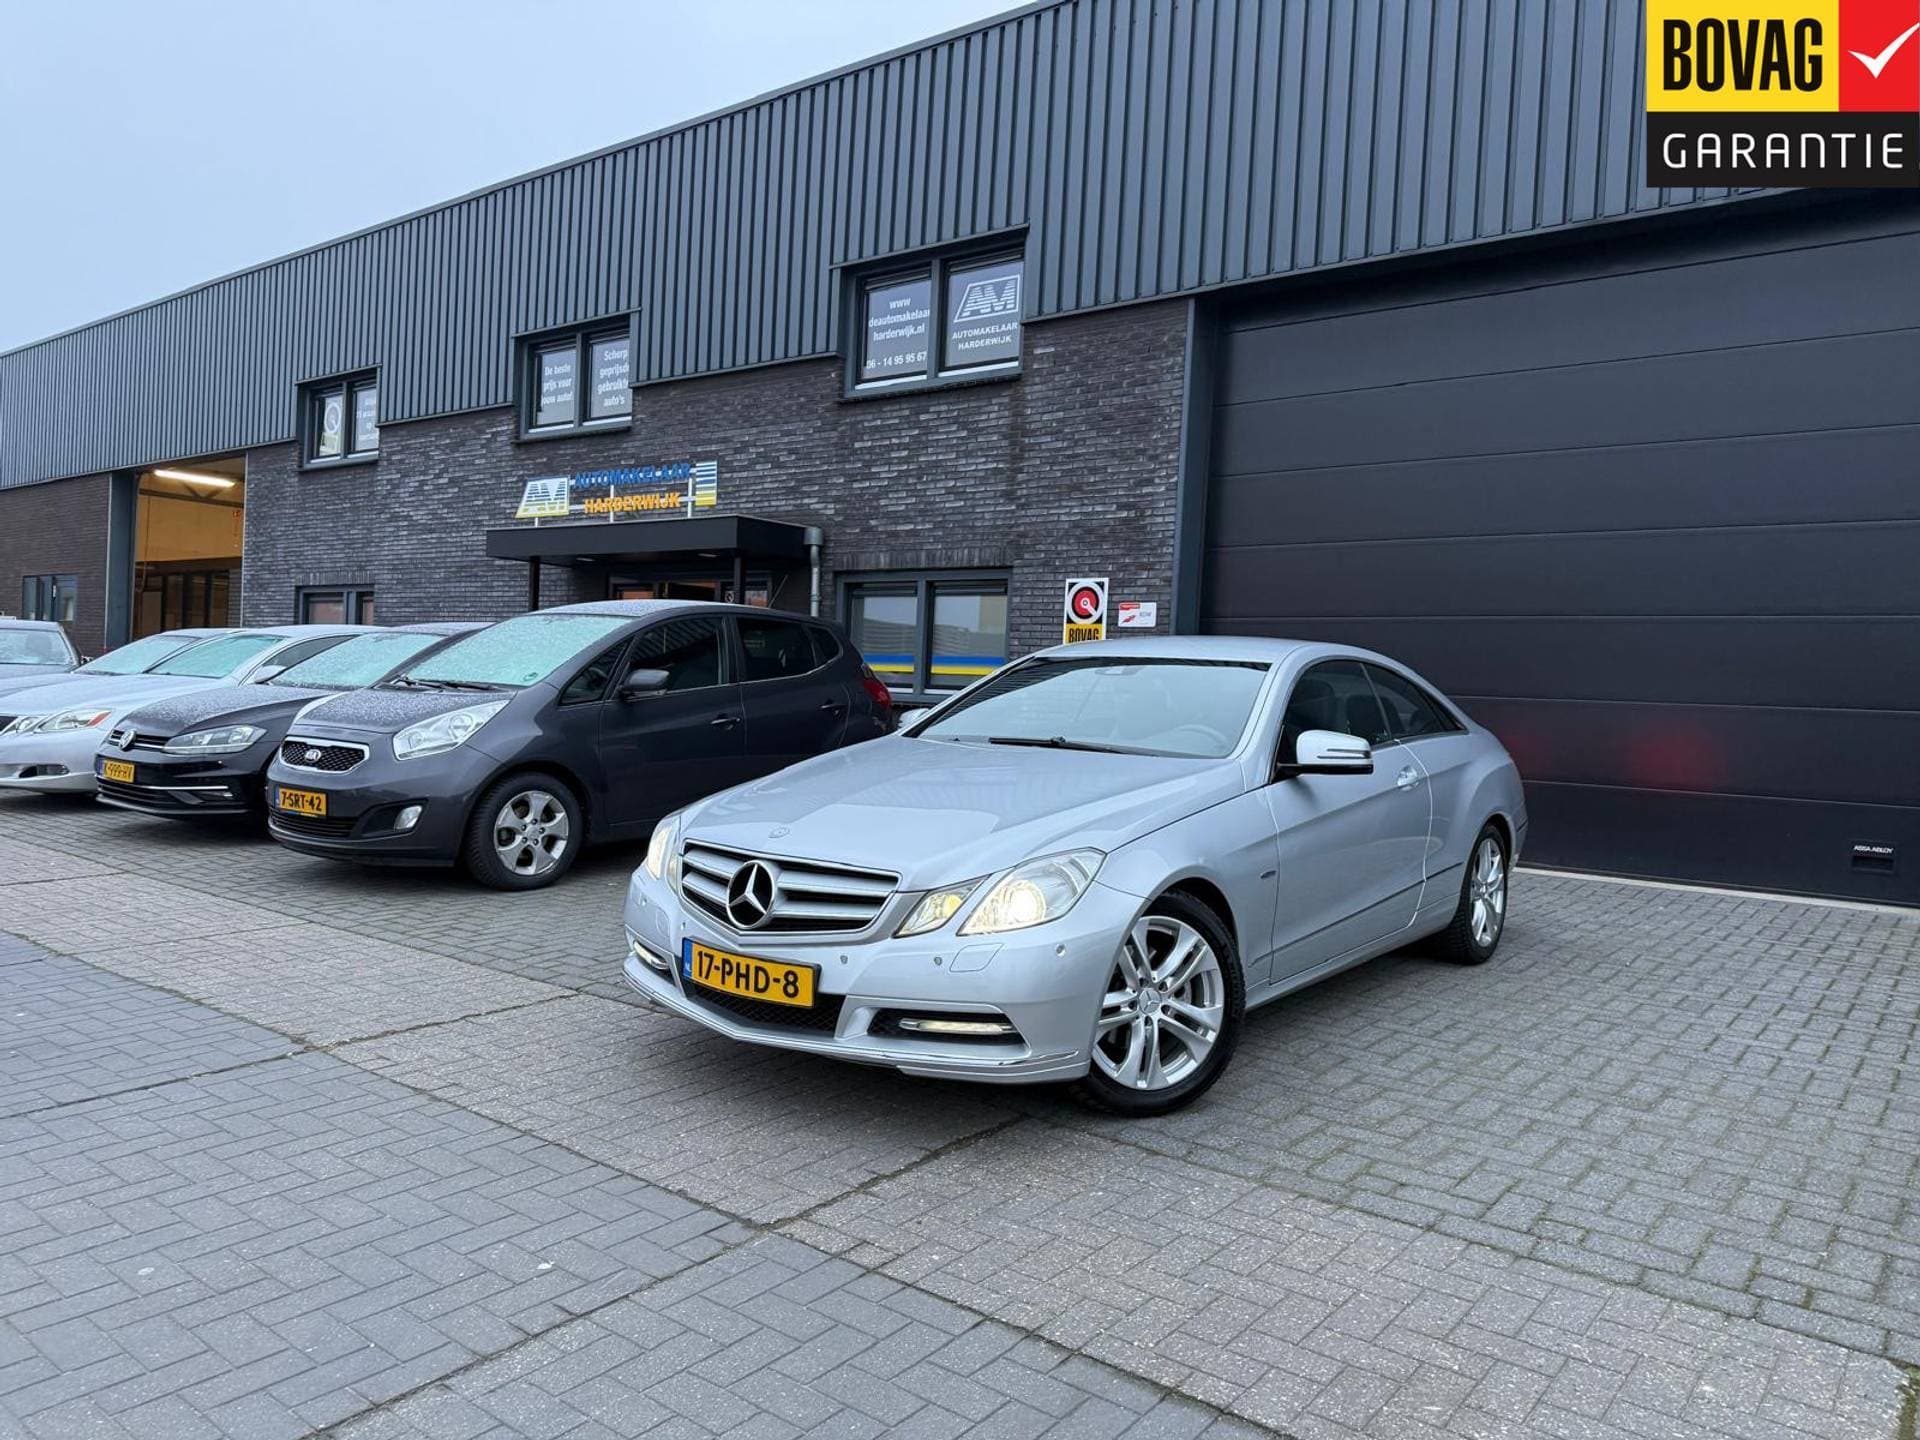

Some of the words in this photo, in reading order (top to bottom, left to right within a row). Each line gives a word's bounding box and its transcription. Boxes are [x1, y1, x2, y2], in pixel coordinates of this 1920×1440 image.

[873, 322, 925, 341] harderwijk.nl
[952, 321, 1018, 339] AUTOMAKELAAR
[958, 335, 1012, 350] HARDERWIJK
[883, 356, 893, 366] 14
[894, 355, 904, 365] 95
[905, 352, 916, 364] 95
[917, 351, 927, 362] 67
[574, 463, 691, 488] AUTOMAKELAAR
[584, 492, 681, 514] HARDERWIJK
[1069, 628, 1099, 643] BOVAG
[281, 791, 322, 811] 7-SRT-42
[697, 950, 800, 999] 17-PHD-8
